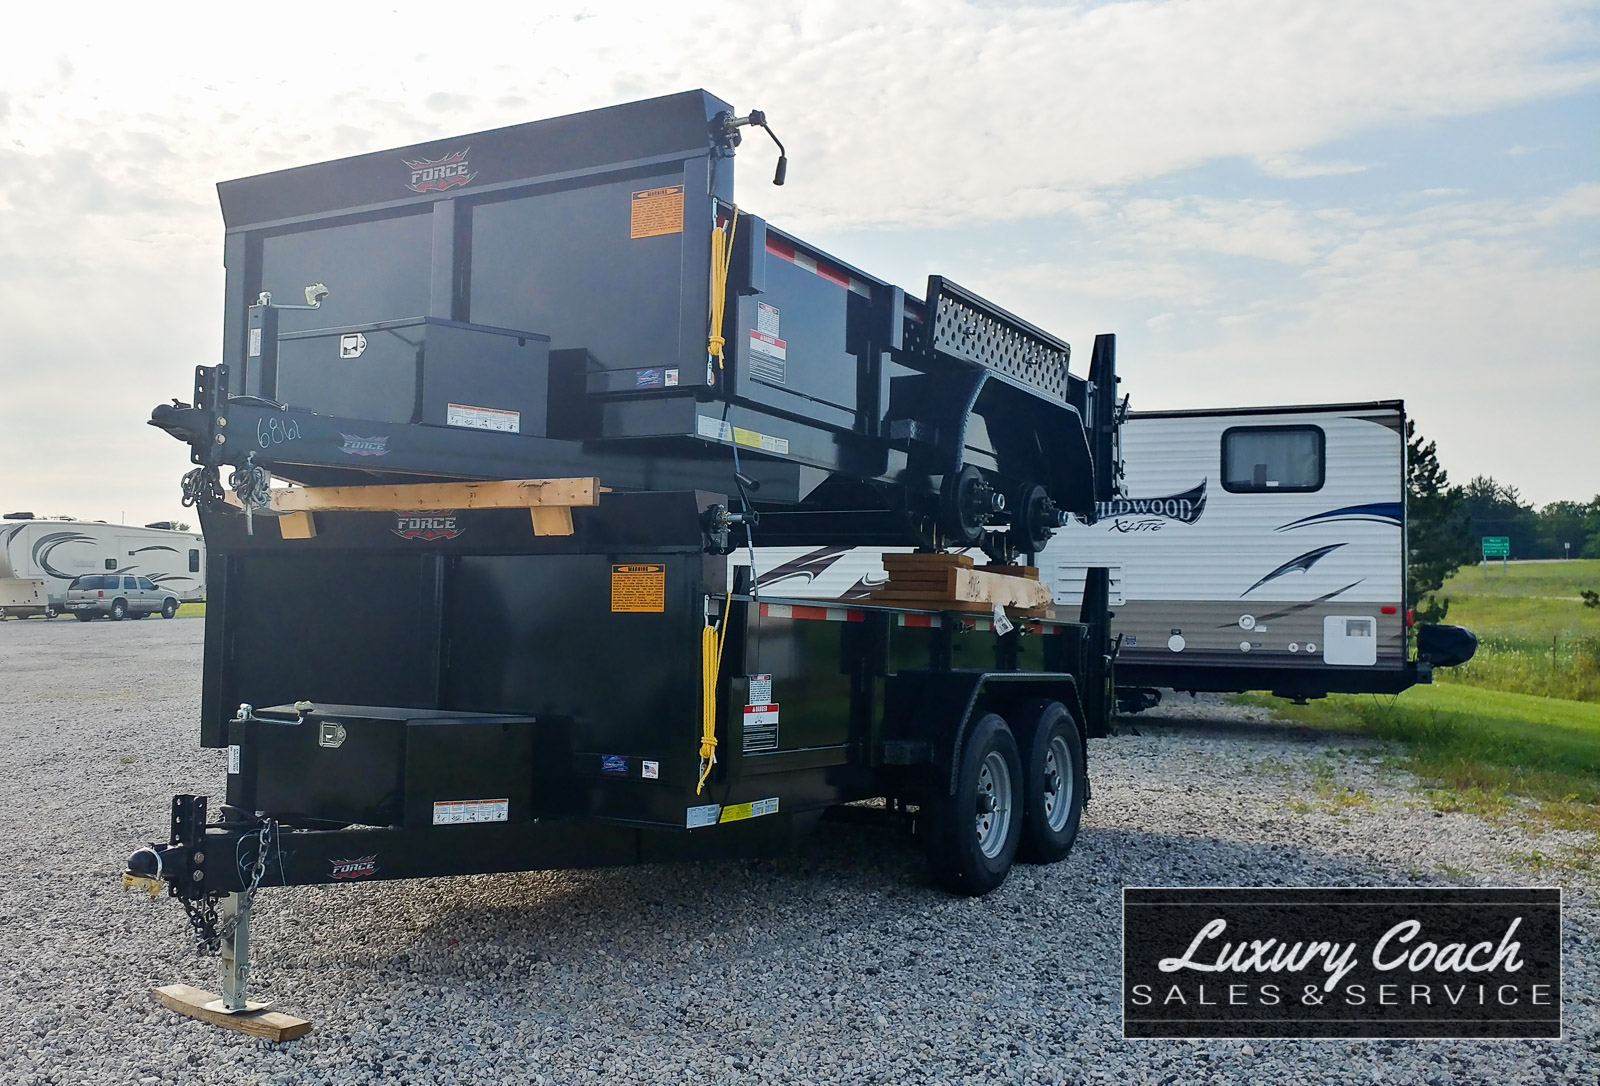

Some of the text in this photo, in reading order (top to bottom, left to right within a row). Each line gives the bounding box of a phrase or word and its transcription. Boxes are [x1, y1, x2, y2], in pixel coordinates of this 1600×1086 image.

[411, 161, 468, 183] FORCE
[343, 439, 387, 451] FORCE
[1096, 499, 1193, 520] ILDWOOD
[398, 516, 457, 529] FORCE
[332, 861, 376, 874] FORCE
